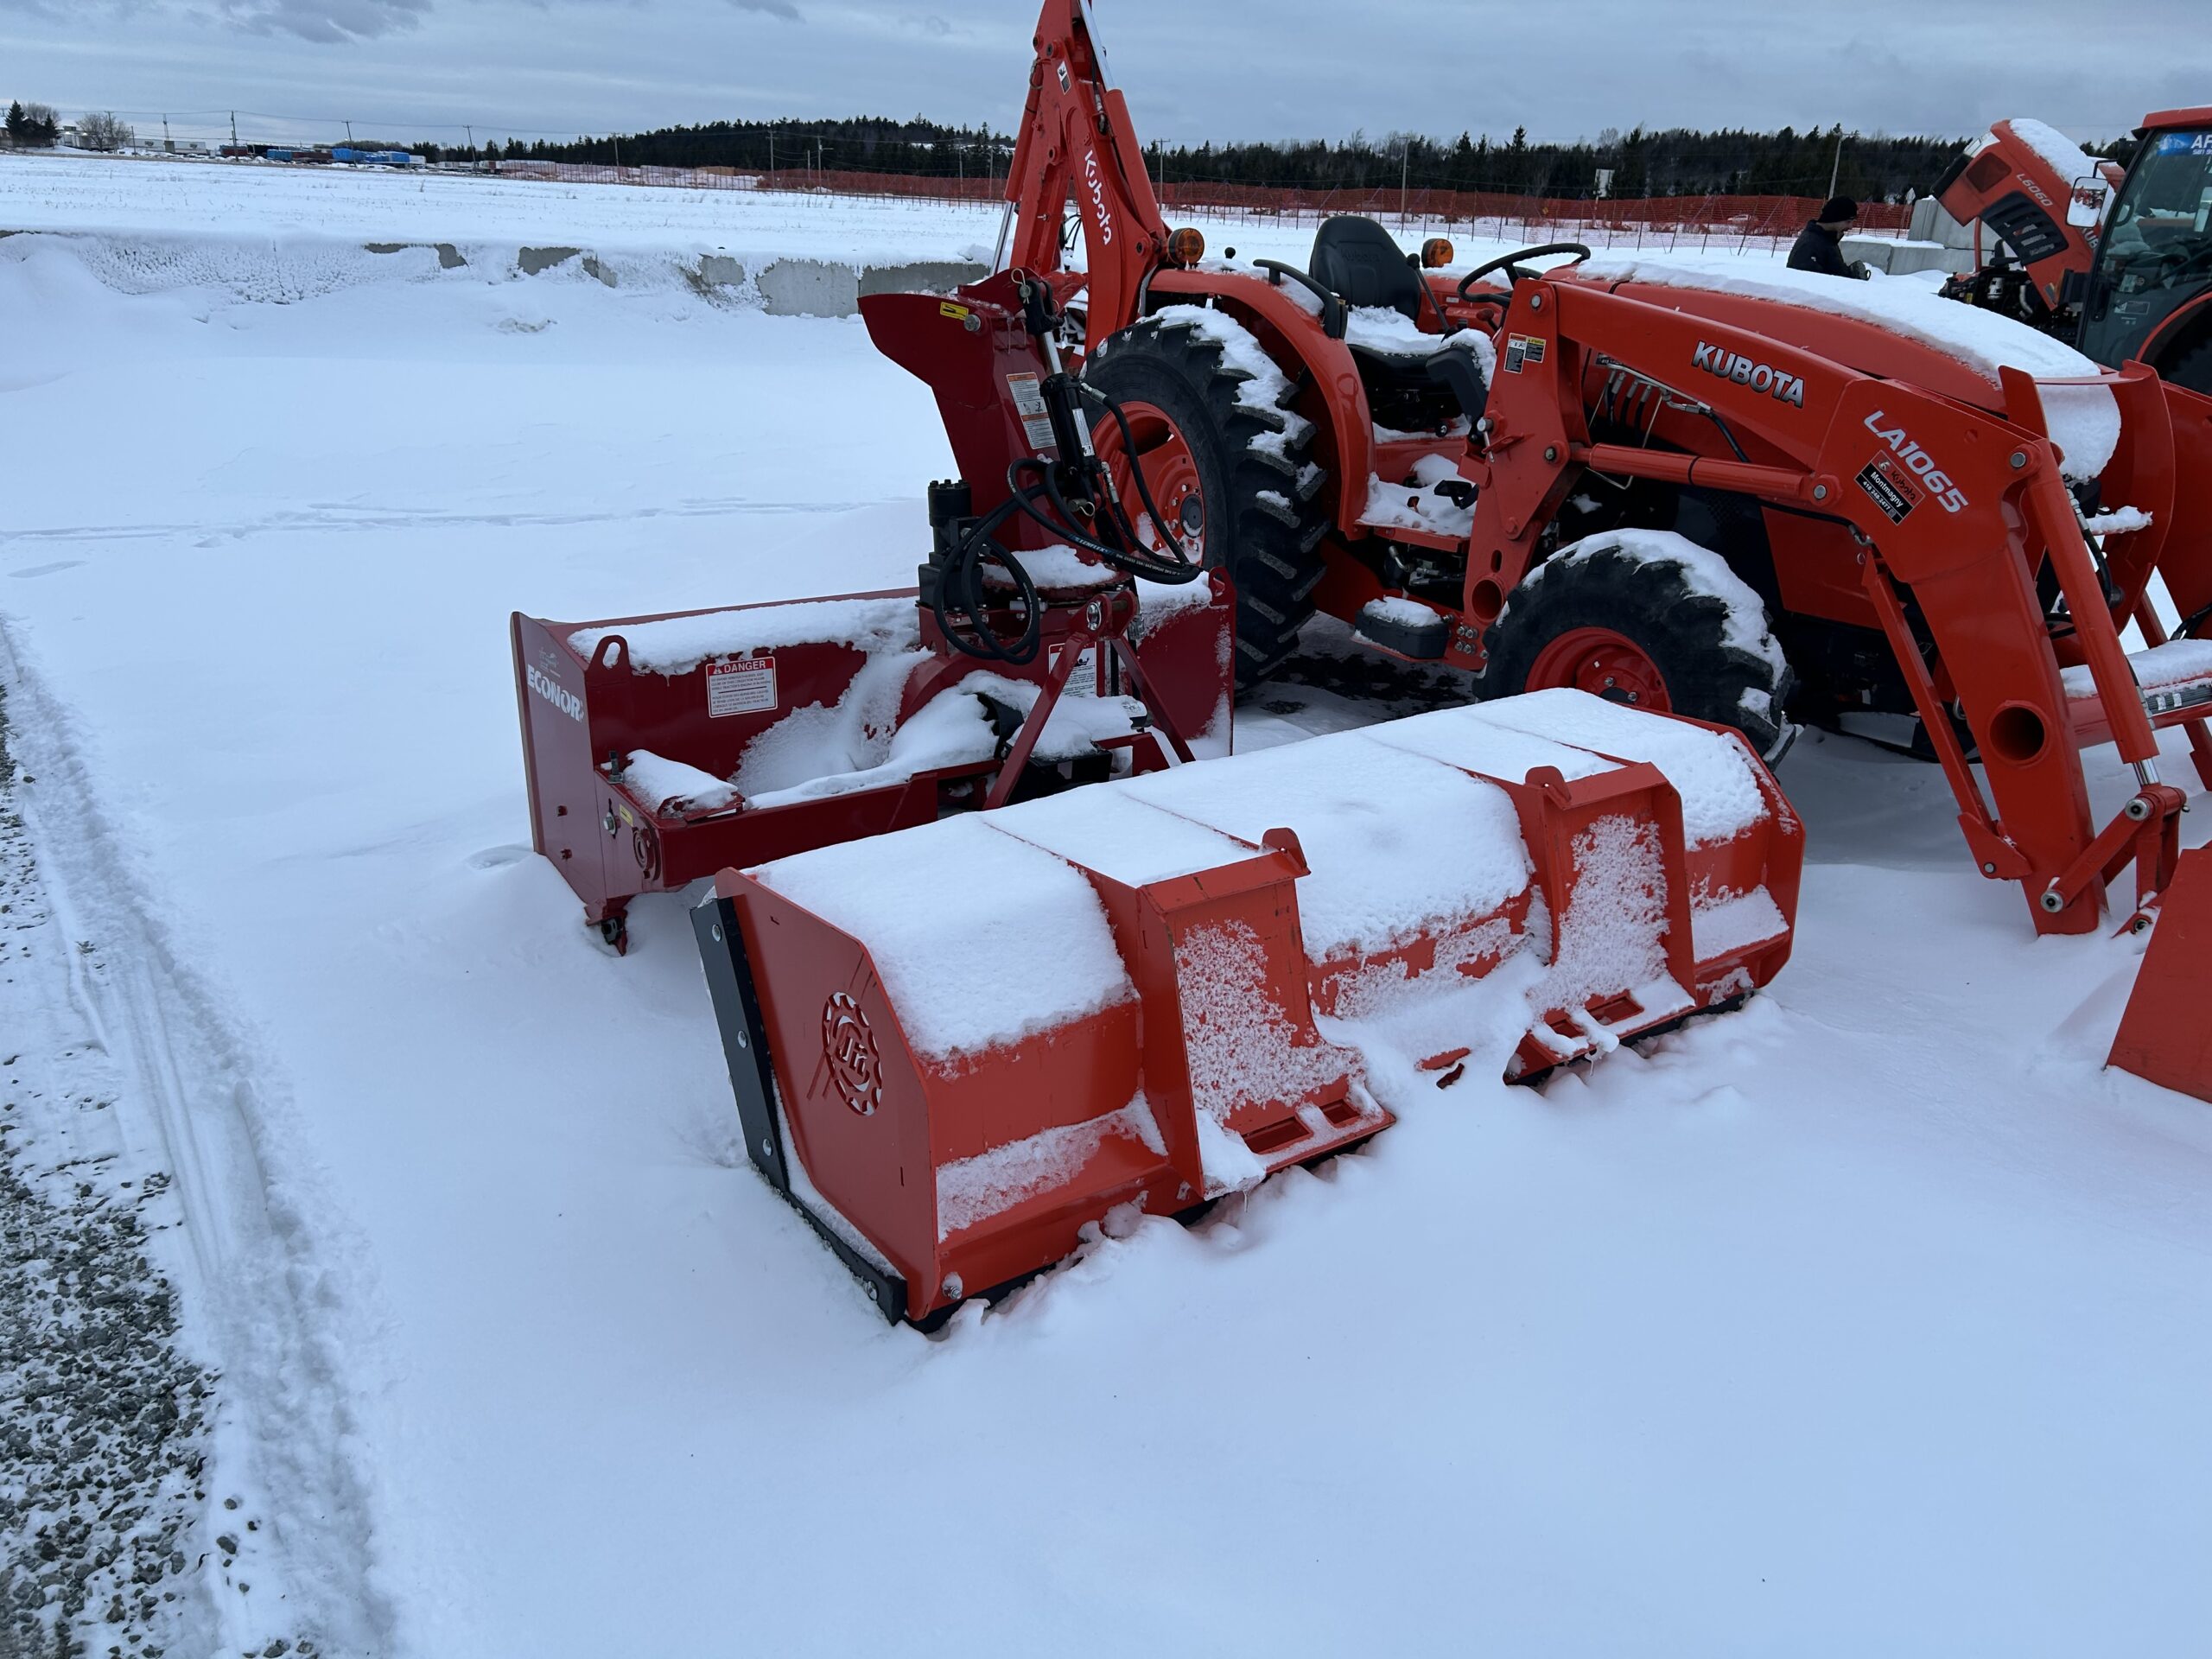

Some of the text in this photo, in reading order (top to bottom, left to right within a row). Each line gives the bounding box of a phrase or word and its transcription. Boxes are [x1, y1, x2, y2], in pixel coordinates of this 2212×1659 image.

[2190, 134, 2212, 149] AF
[1084, 149, 1112, 245] Kubota
[2017, 173, 2054, 207] L6060
[1691, 340, 1805, 410] KUBOTA
[1863, 410, 1969, 512] LA1065
[1863, 481, 1872, 491] 418
[1870, 471, 1904, 508] Montmagny
[1891, 470, 1916, 500] Kubota
[723, 659, 766, 673] DANGER
[527, 664, 582, 721] ECONOR
